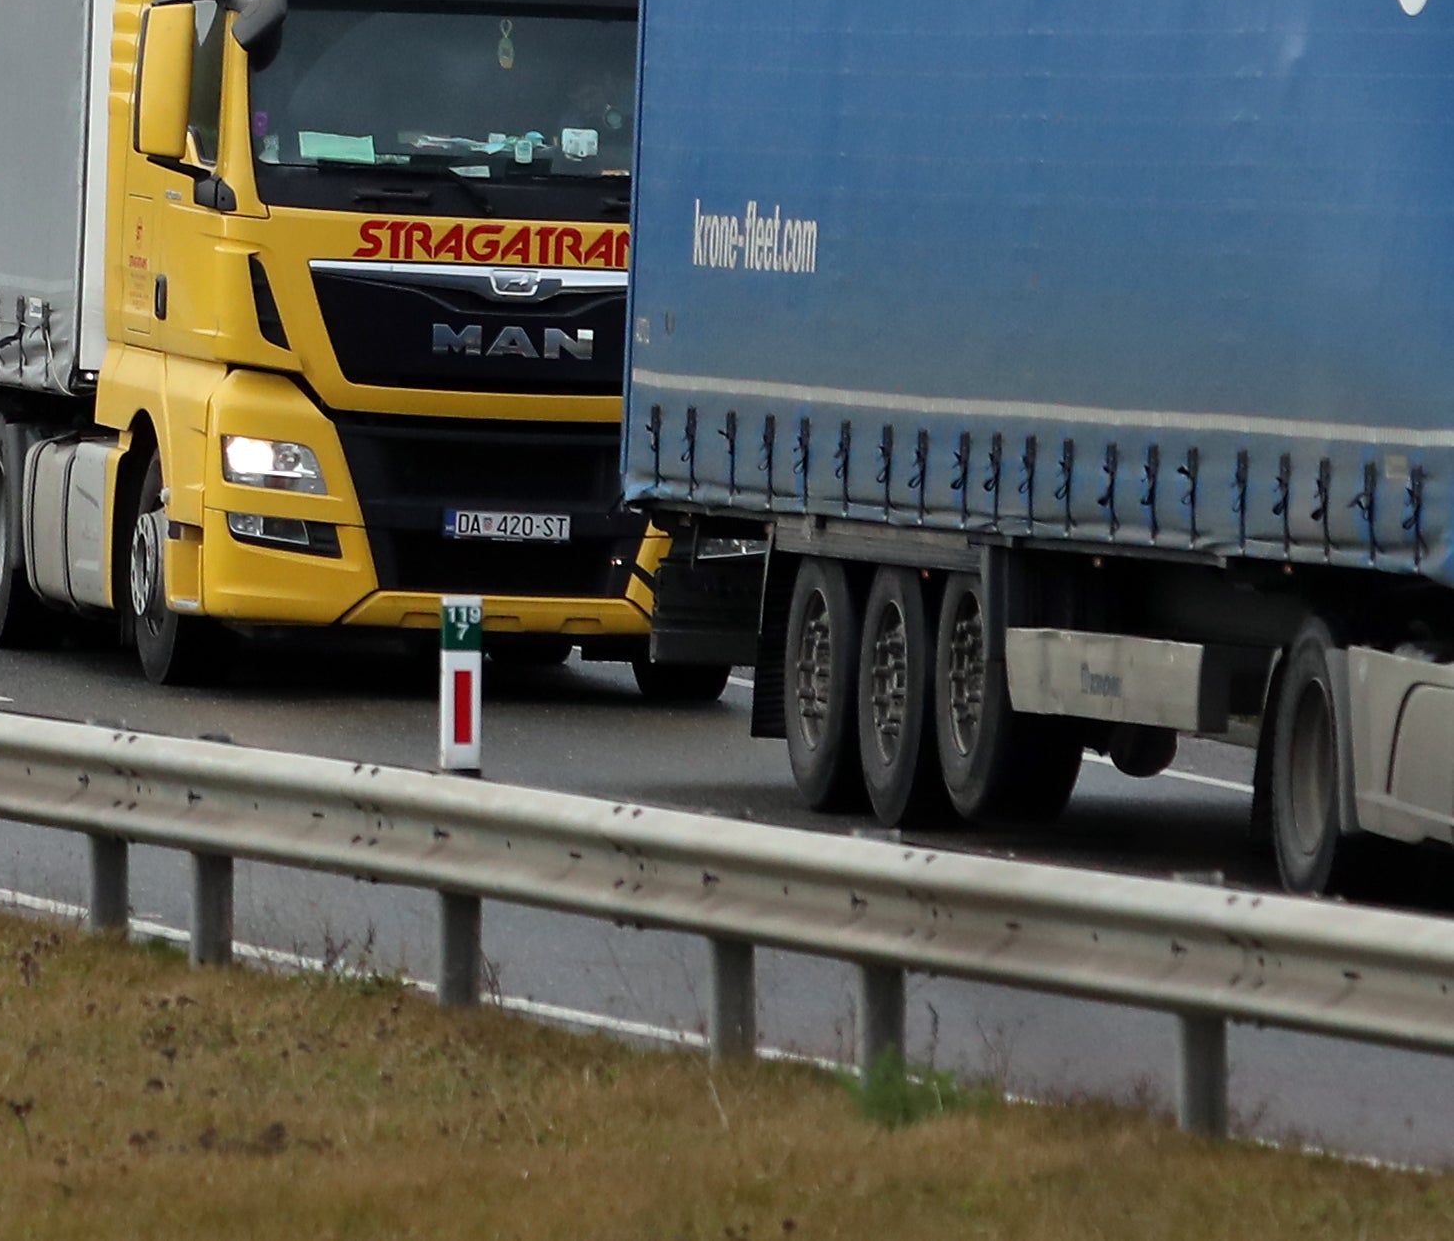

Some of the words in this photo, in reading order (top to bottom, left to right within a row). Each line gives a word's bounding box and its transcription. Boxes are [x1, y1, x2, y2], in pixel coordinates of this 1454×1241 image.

[693, 198, 817, 273] krone-fleet.com
[432, 323, 594, 360] MAN
[458, 513, 481, 534] DA
[497, 515, 568, 538] 420-ST
[448, 607, 481, 624] 119
[456, 623, 470, 640] 7
